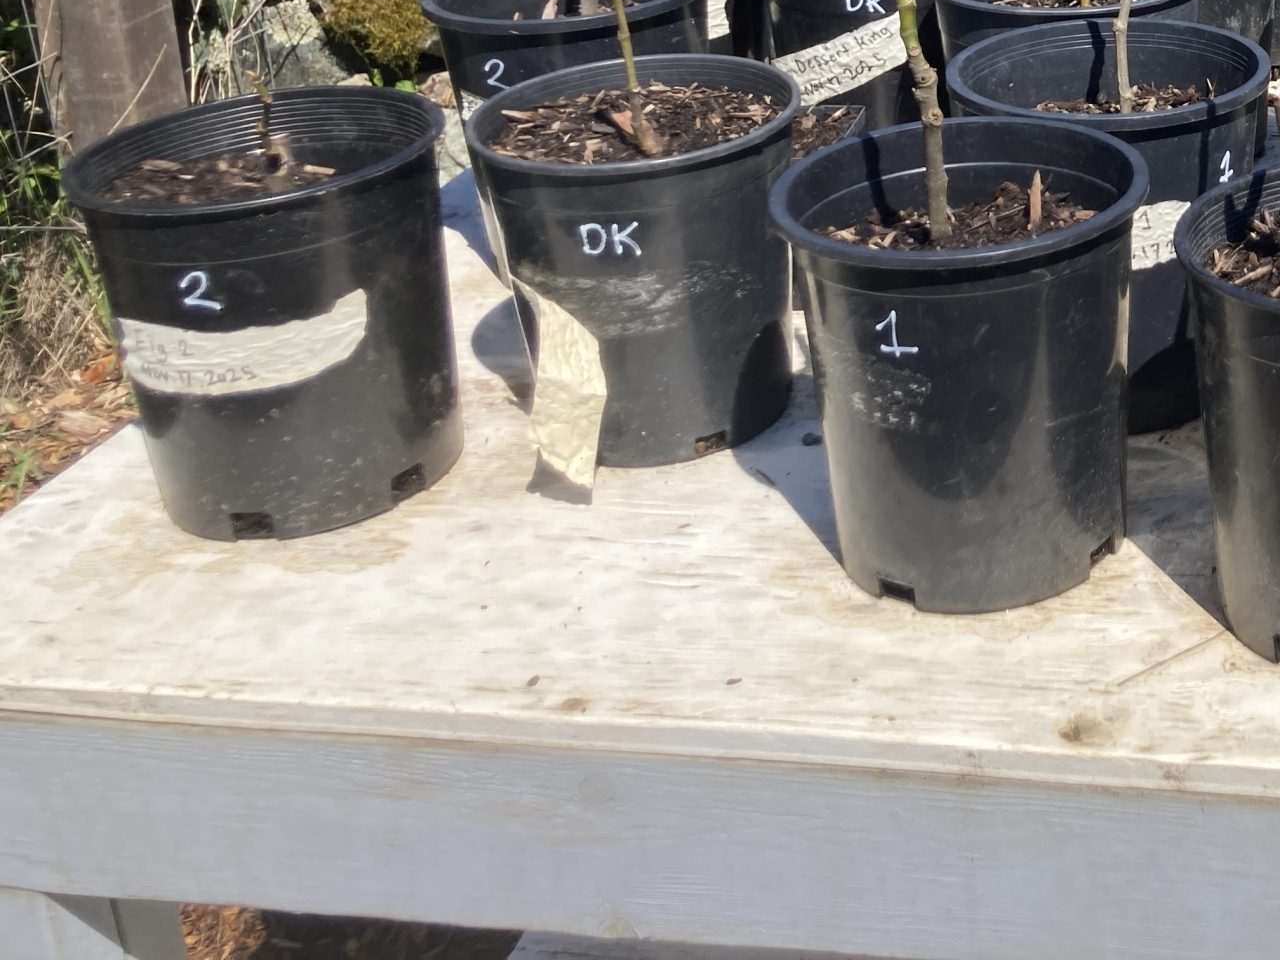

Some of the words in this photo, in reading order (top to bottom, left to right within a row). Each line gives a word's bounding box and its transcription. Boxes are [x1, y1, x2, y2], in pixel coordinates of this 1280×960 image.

[794, 43, 850, 74] Dessert
[854, 26, 895, 49] King
[483, 58, 511, 90] 2
[1219, 150, 1233, 183] 1
[580, 221, 642, 256] DK
[180, 270, 225, 310] 2
[875, 309, 919, 358] 1
